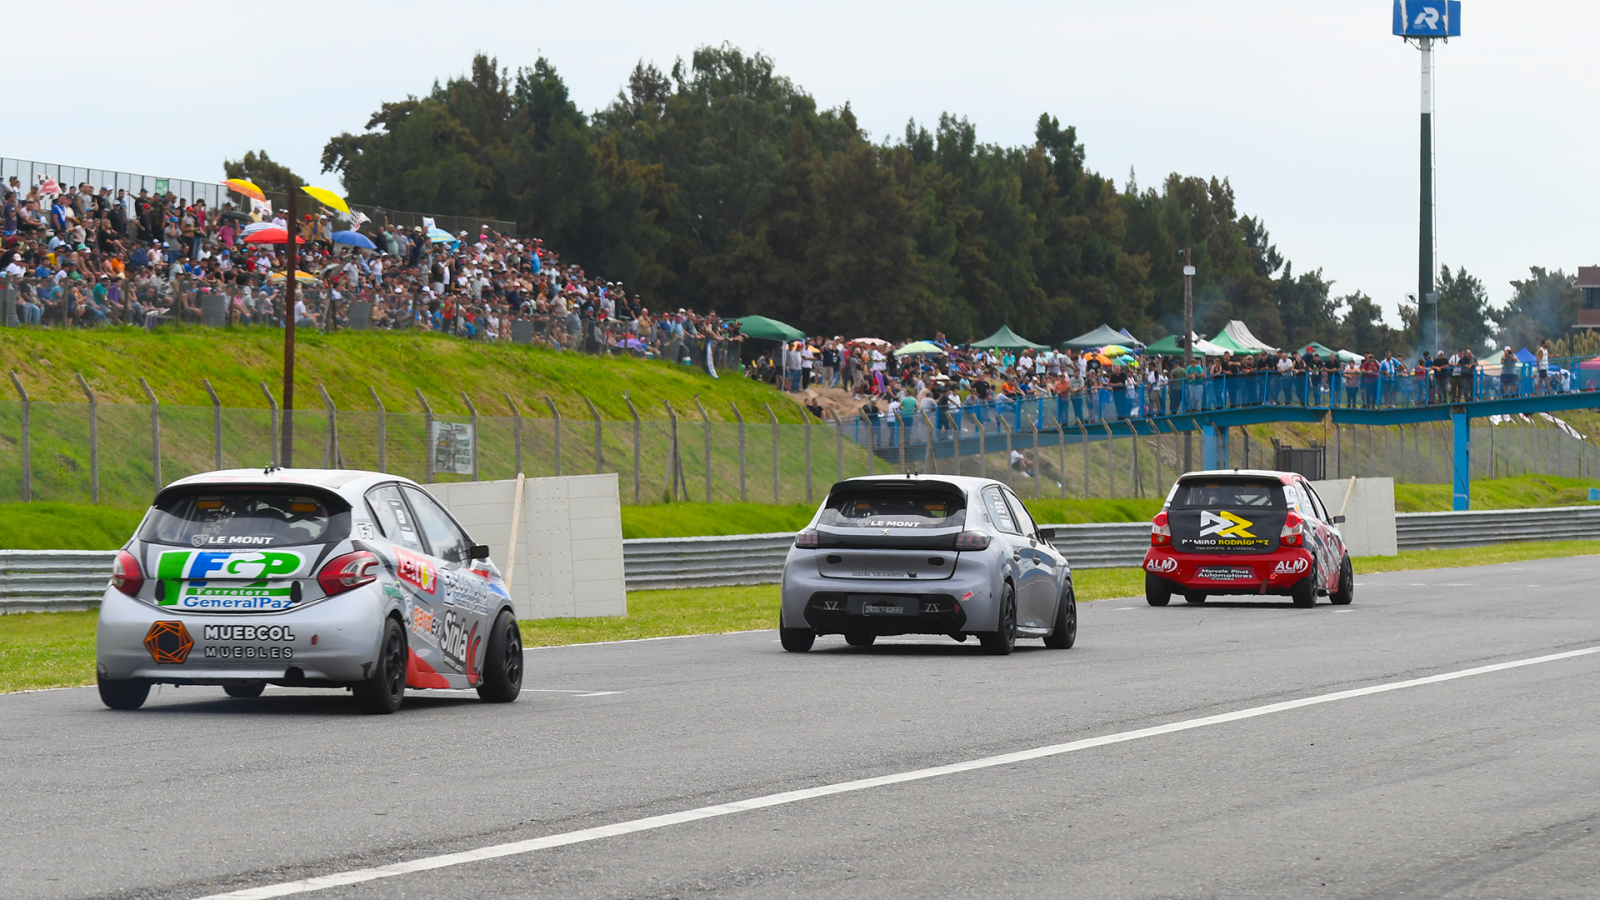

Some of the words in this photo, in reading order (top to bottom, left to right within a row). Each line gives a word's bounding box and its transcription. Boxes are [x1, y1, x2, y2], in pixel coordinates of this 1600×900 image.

[208, 536, 227, 544] LE
[228, 536, 274, 545] MONT
[1146, 558, 1173, 570] ALM
[1275, 560, 1304, 570] ALM
[196, 588, 270, 596] Ferretera
[204, 624, 295, 641] MUEBCOL
[204, 646, 294, 659] MUEBLES
